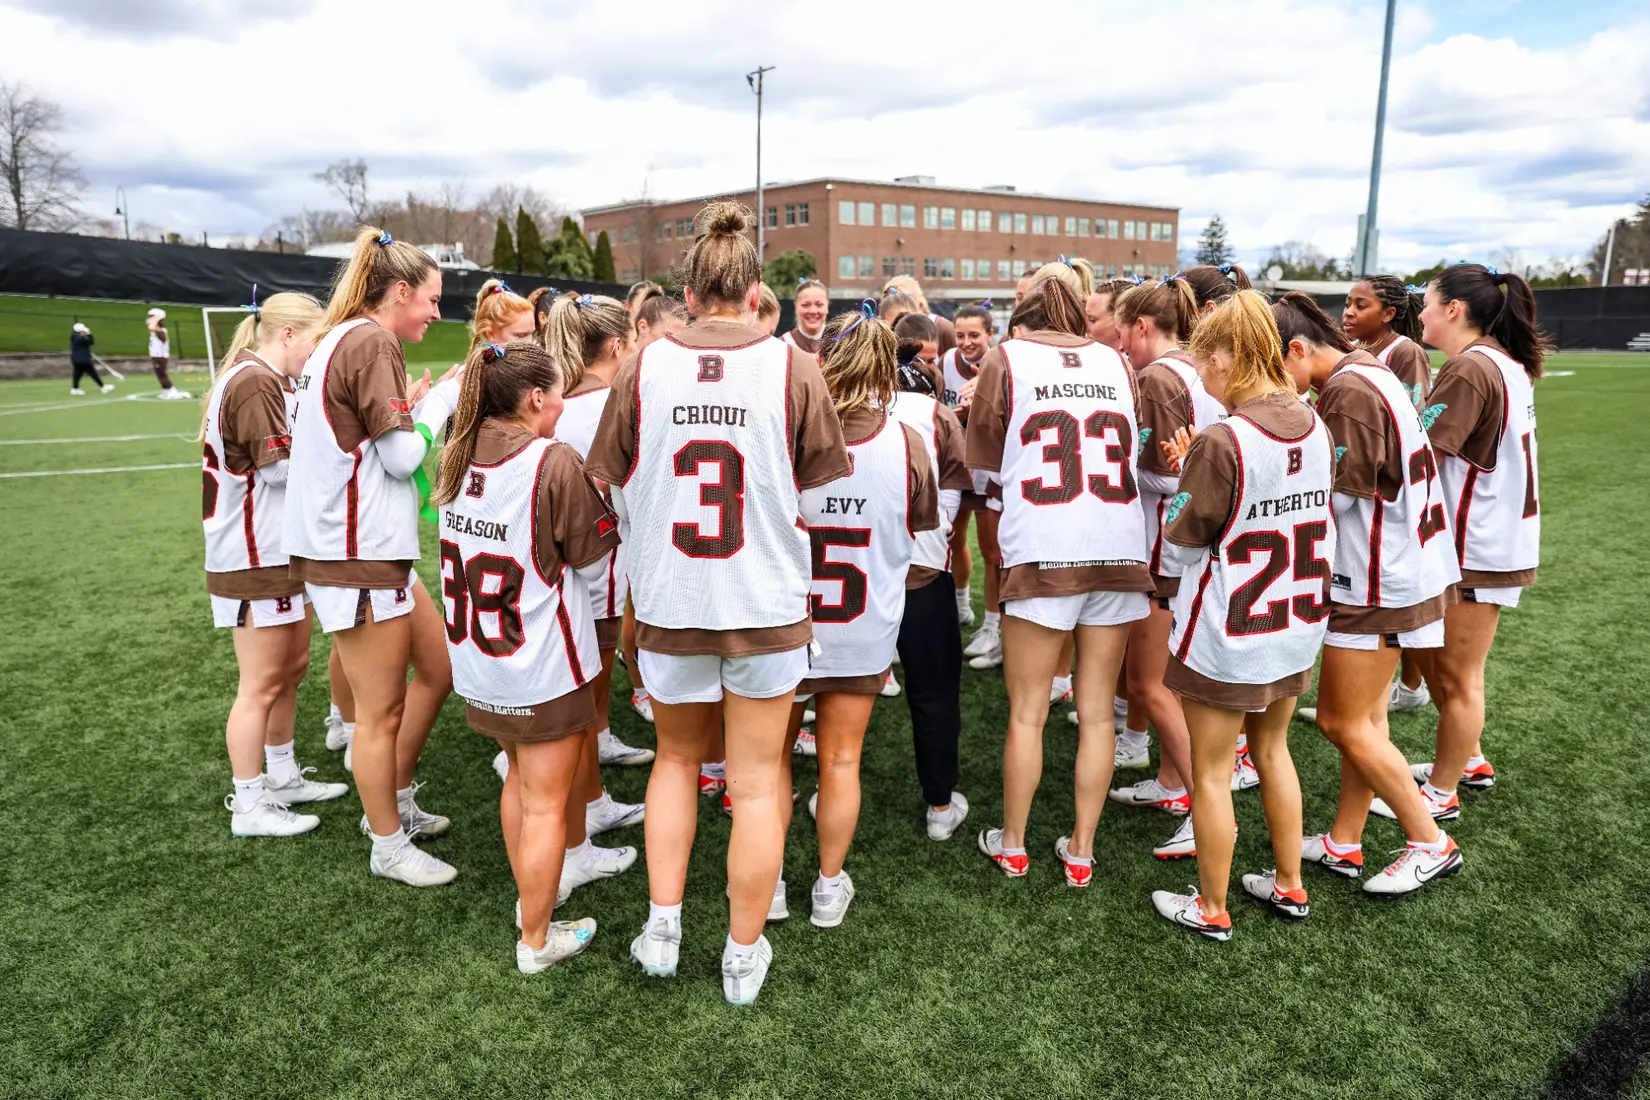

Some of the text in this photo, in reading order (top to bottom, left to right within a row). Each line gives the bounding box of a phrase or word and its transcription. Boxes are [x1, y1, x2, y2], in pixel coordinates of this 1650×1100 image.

[698, 354, 724, 382] B
[1059, 351, 1082, 368] B
[1034, 383, 1117, 401] MASCONE
[672, 405, 747, 427] CRIQUI
[1019, 409, 1139, 506] 33
[1286, 446, 1303, 476] B
[465, 470, 487, 499] B
[672, 440, 745, 559] 3
[820, 496, 868, 515] EVY
[1245, 489, 1329, 520] ATHERTO
[807, 526, 872, 624] 5
[1225, 519, 1333, 637] 25
[439, 538, 527, 658] 38
